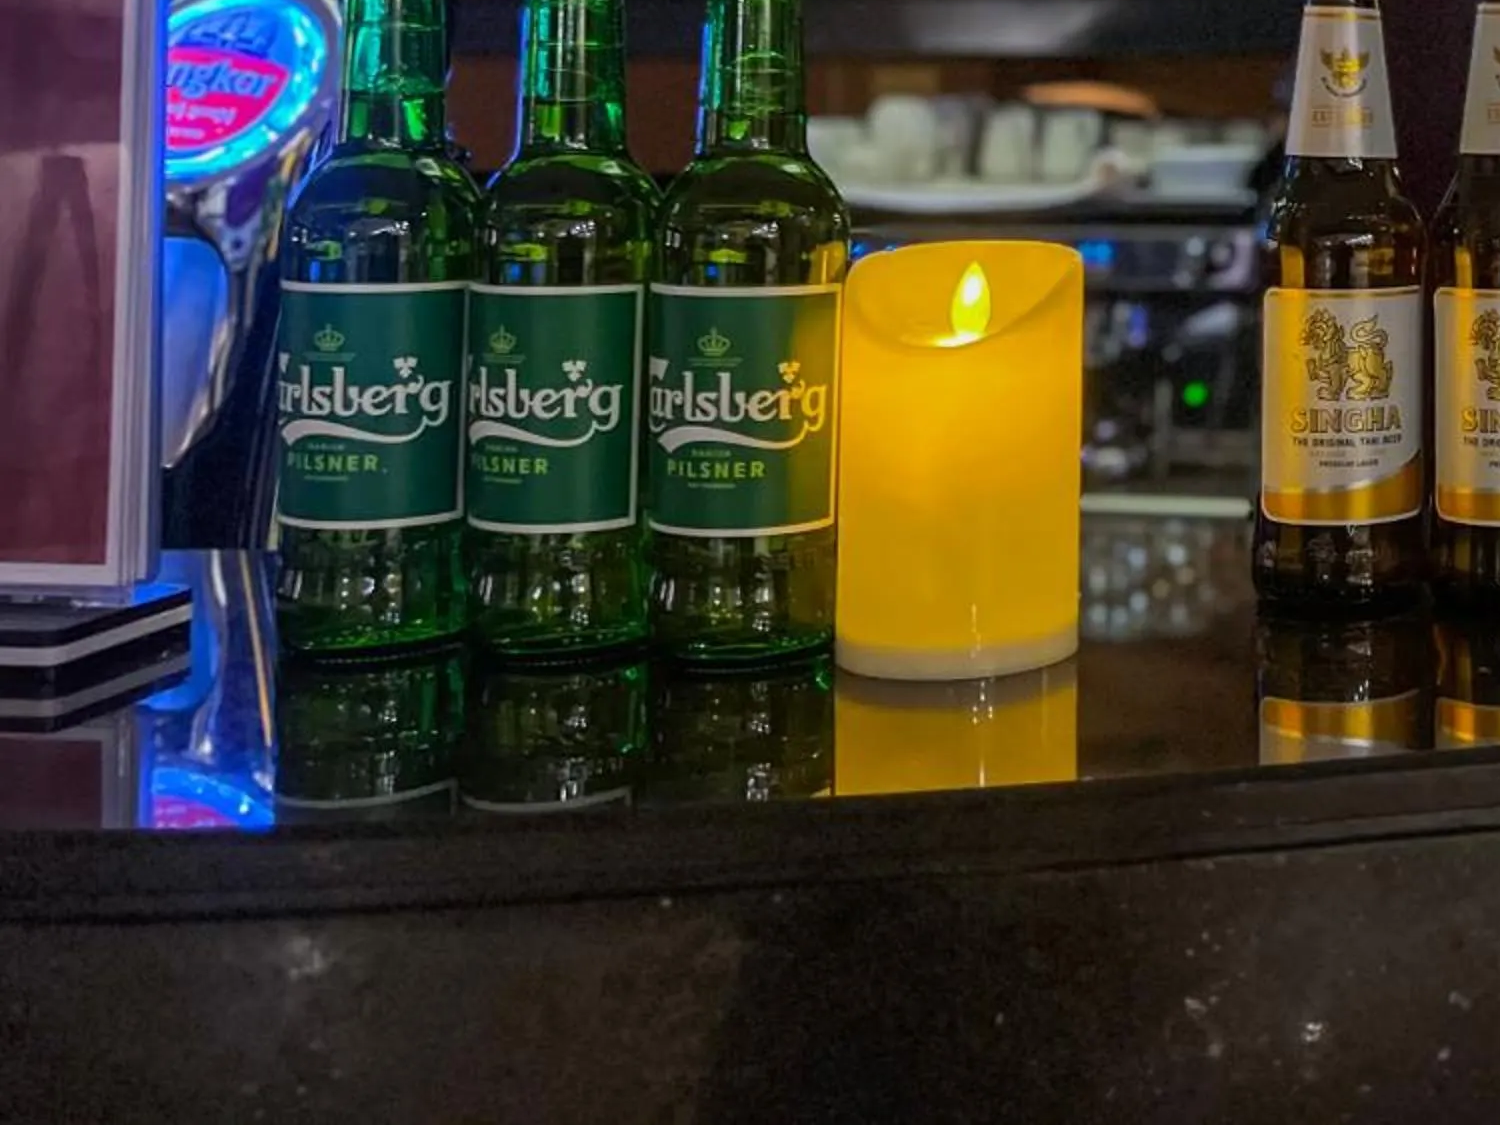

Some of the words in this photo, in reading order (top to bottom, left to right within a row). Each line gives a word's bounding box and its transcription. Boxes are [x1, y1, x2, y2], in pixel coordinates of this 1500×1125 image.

[169, 61, 274, 99] ngkor
[278, 352, 452, 428] rlsberg
[468, 355, 623, 433] rlsberg
[1290, 405, 1402, 435] SINGHA
[667, 458, 765, 479] PILSNER
